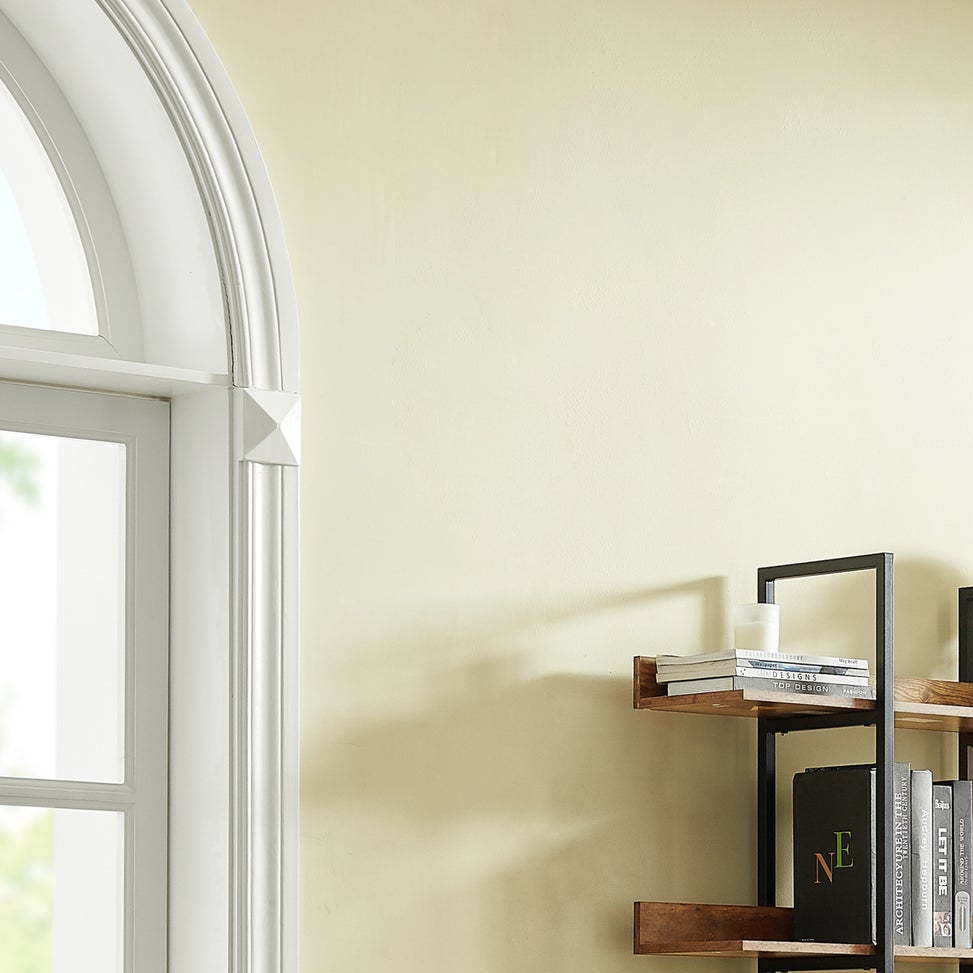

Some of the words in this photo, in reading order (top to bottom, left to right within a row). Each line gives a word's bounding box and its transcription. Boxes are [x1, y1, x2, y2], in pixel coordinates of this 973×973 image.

[772, 671, 818, 682] DESIGNS
[772, 681, 792, 690] TOP
[795, 683, 829, 693] DESIGN
[895, 792, 904, 819] THE
[895, 821, 904, 835] IN
[938, 828, 947, 855] LET
[938, 858, 947, 874] IT
[938, 877, 947, 896] BE
